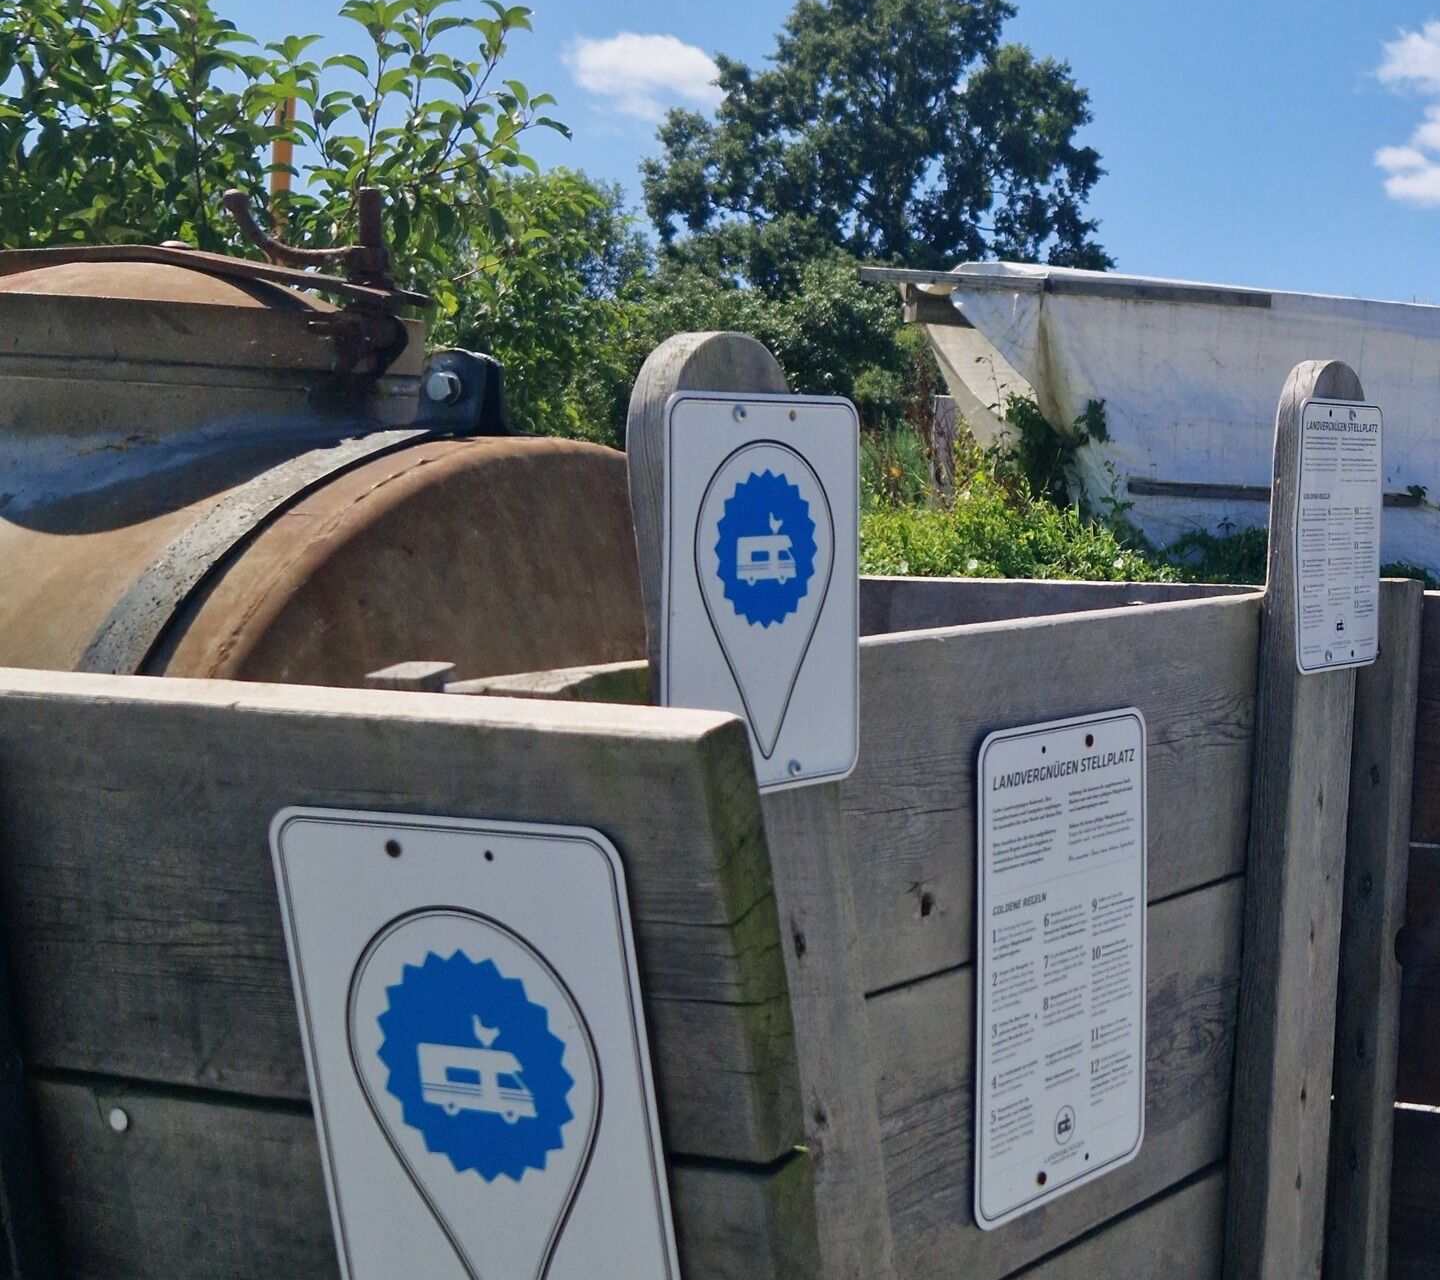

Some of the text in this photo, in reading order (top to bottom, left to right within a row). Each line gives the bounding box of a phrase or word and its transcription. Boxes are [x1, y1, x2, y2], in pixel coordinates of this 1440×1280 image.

[1347, 423, 1378, 433] STELLPLATZ
[993, 748, 1135, 791] LANDVERGNÜGEN STELLPLATZ
[1091, 898, 1098, 913] 9
[1043, 913, 1050, 927] 6
[992, 929, 997, 944] 1
[1091, 946, 1102, 961] 10
[1044, 955, 1049, 970] 7
[992, 972, 998, 987] 2
[1091, 1028, 1099, 1042] 11
[1090, 1058, 1100, 1074] 12
[990, 1110, 997, 1125] 5
